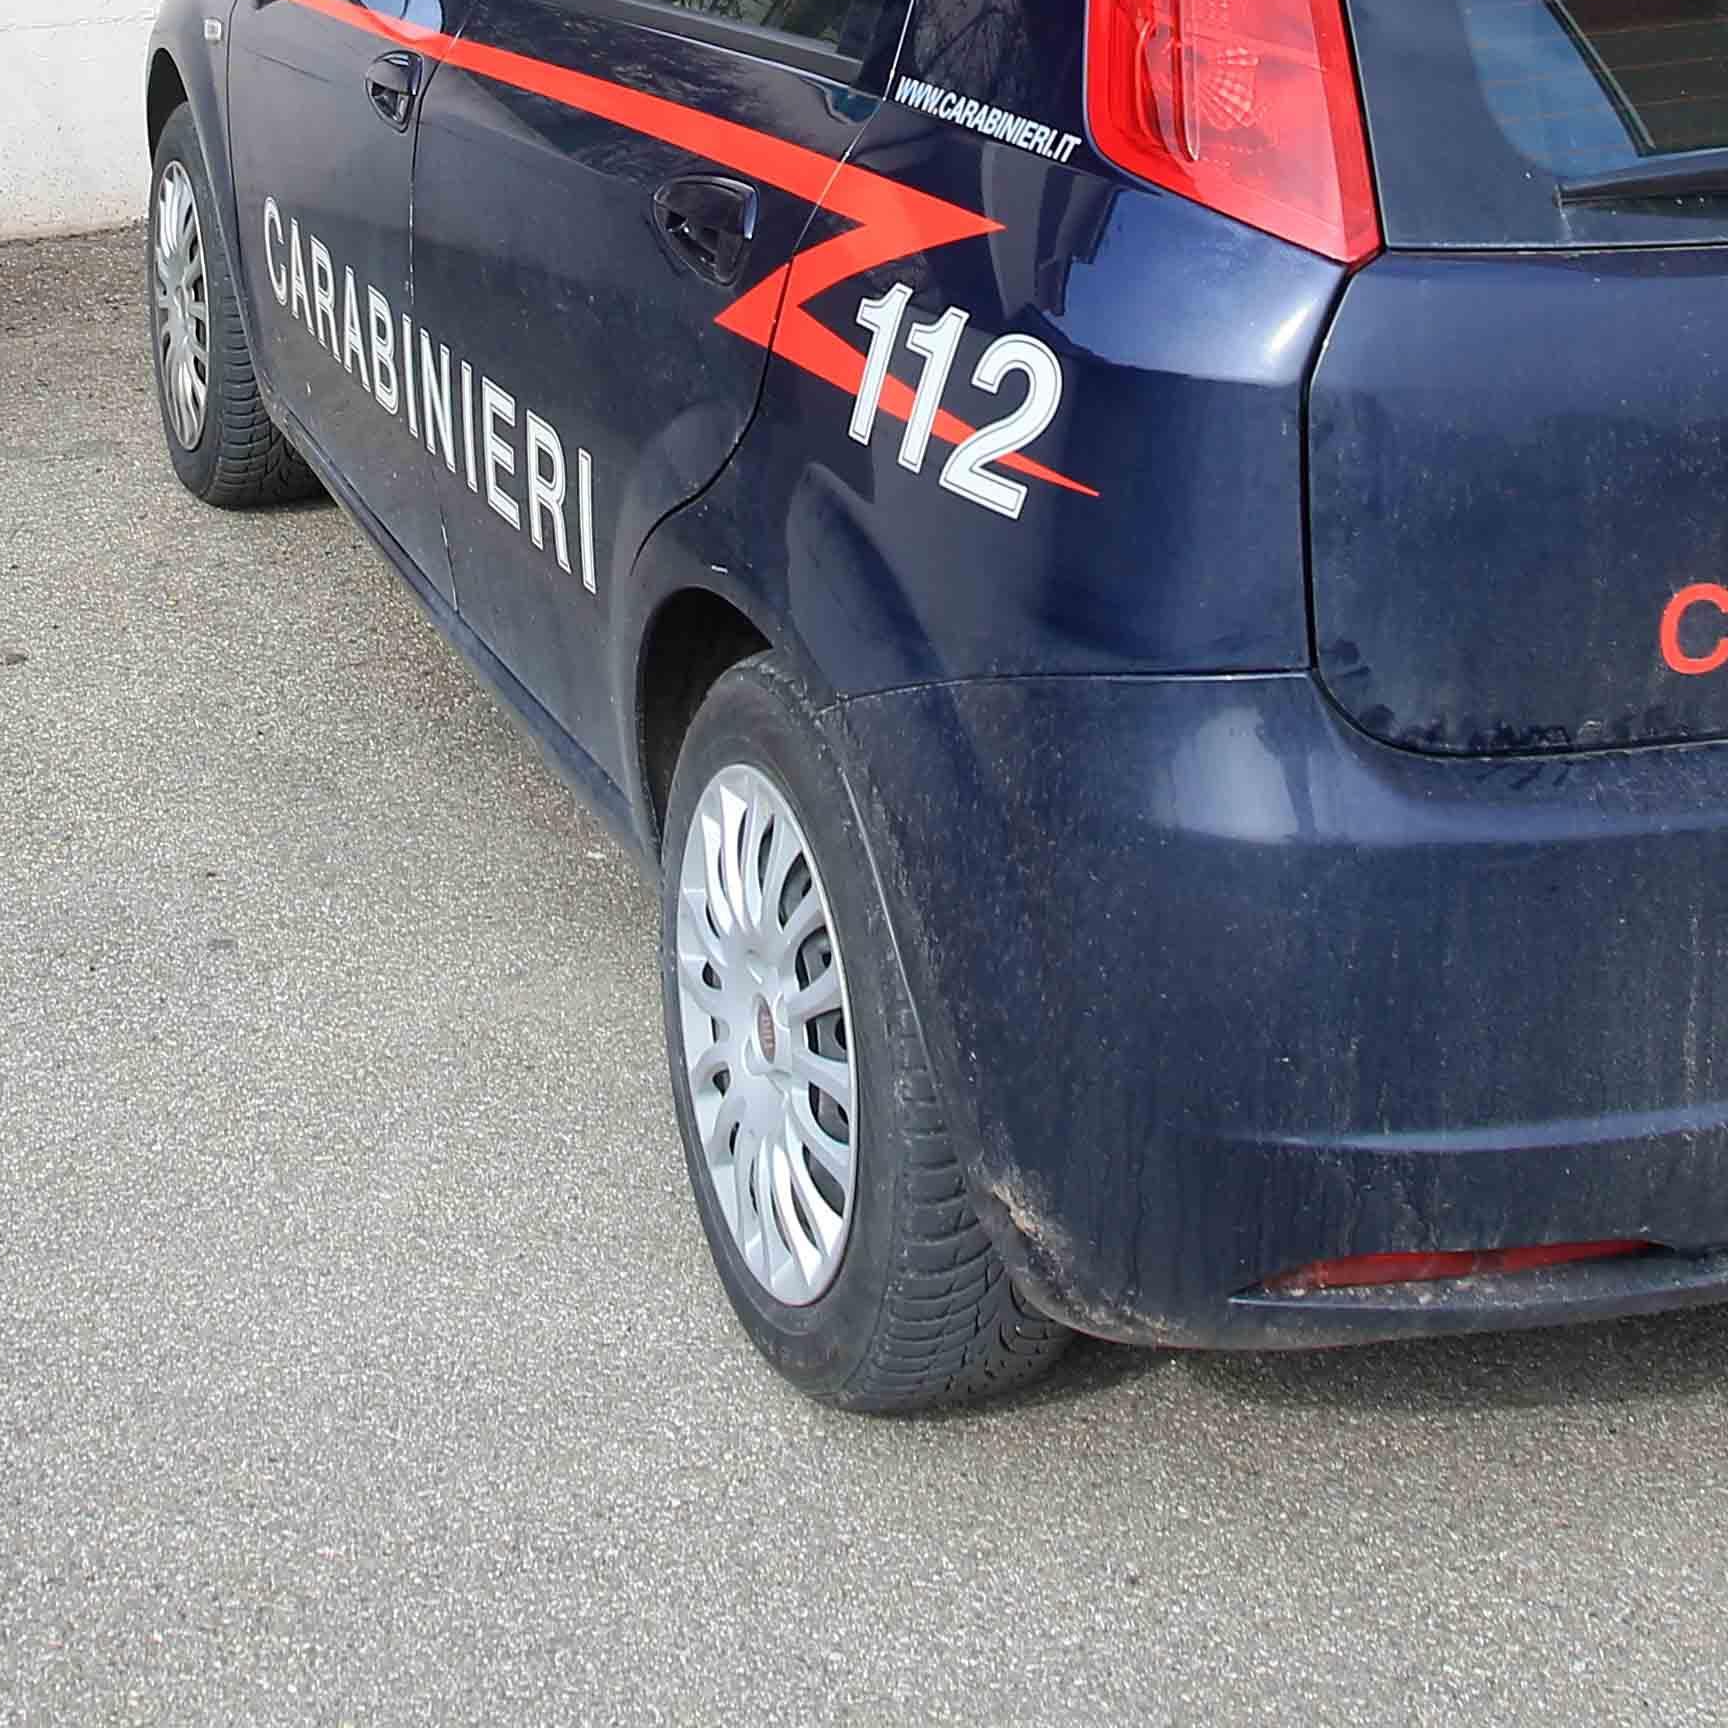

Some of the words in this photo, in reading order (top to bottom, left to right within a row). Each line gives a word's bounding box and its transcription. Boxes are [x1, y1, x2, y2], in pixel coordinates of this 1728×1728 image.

[895, 75, 1082, 162] WWW.CARABINIERI.IT
[264, 196, 596, 594] CARABINIERI
[848, 282, 1062, 520] 112
